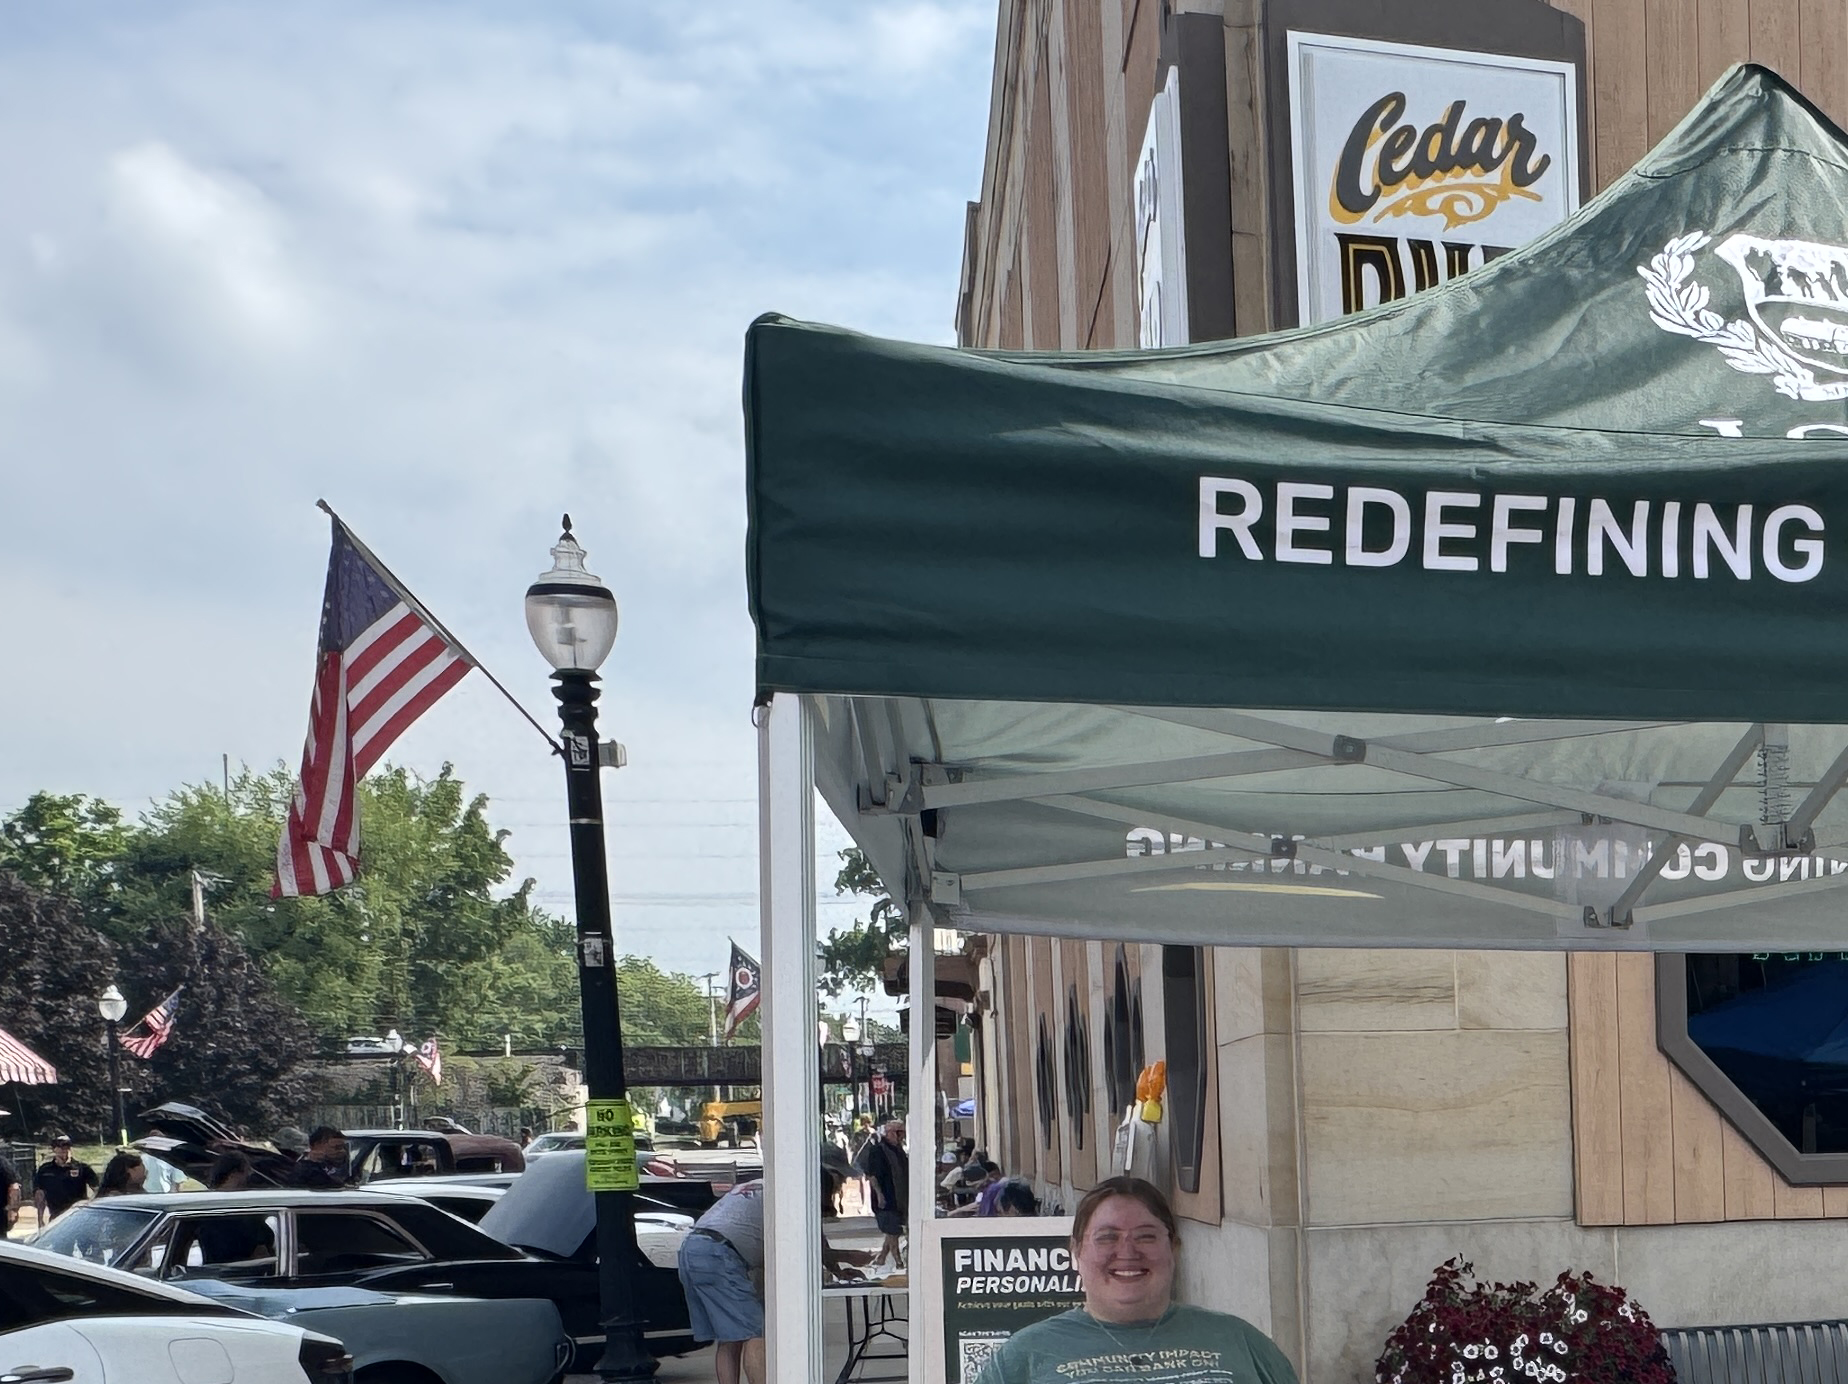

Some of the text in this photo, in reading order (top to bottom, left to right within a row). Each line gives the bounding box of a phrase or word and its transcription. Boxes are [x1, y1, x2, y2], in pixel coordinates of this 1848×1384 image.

[1331, 91, 1551, 220] Cedar
[1199, 476, 1825, 583] REDEFINING
[956, 1275, 1087, 1294] PERSONALI
[1159, 1348, 1223, 1360] IMPACT
